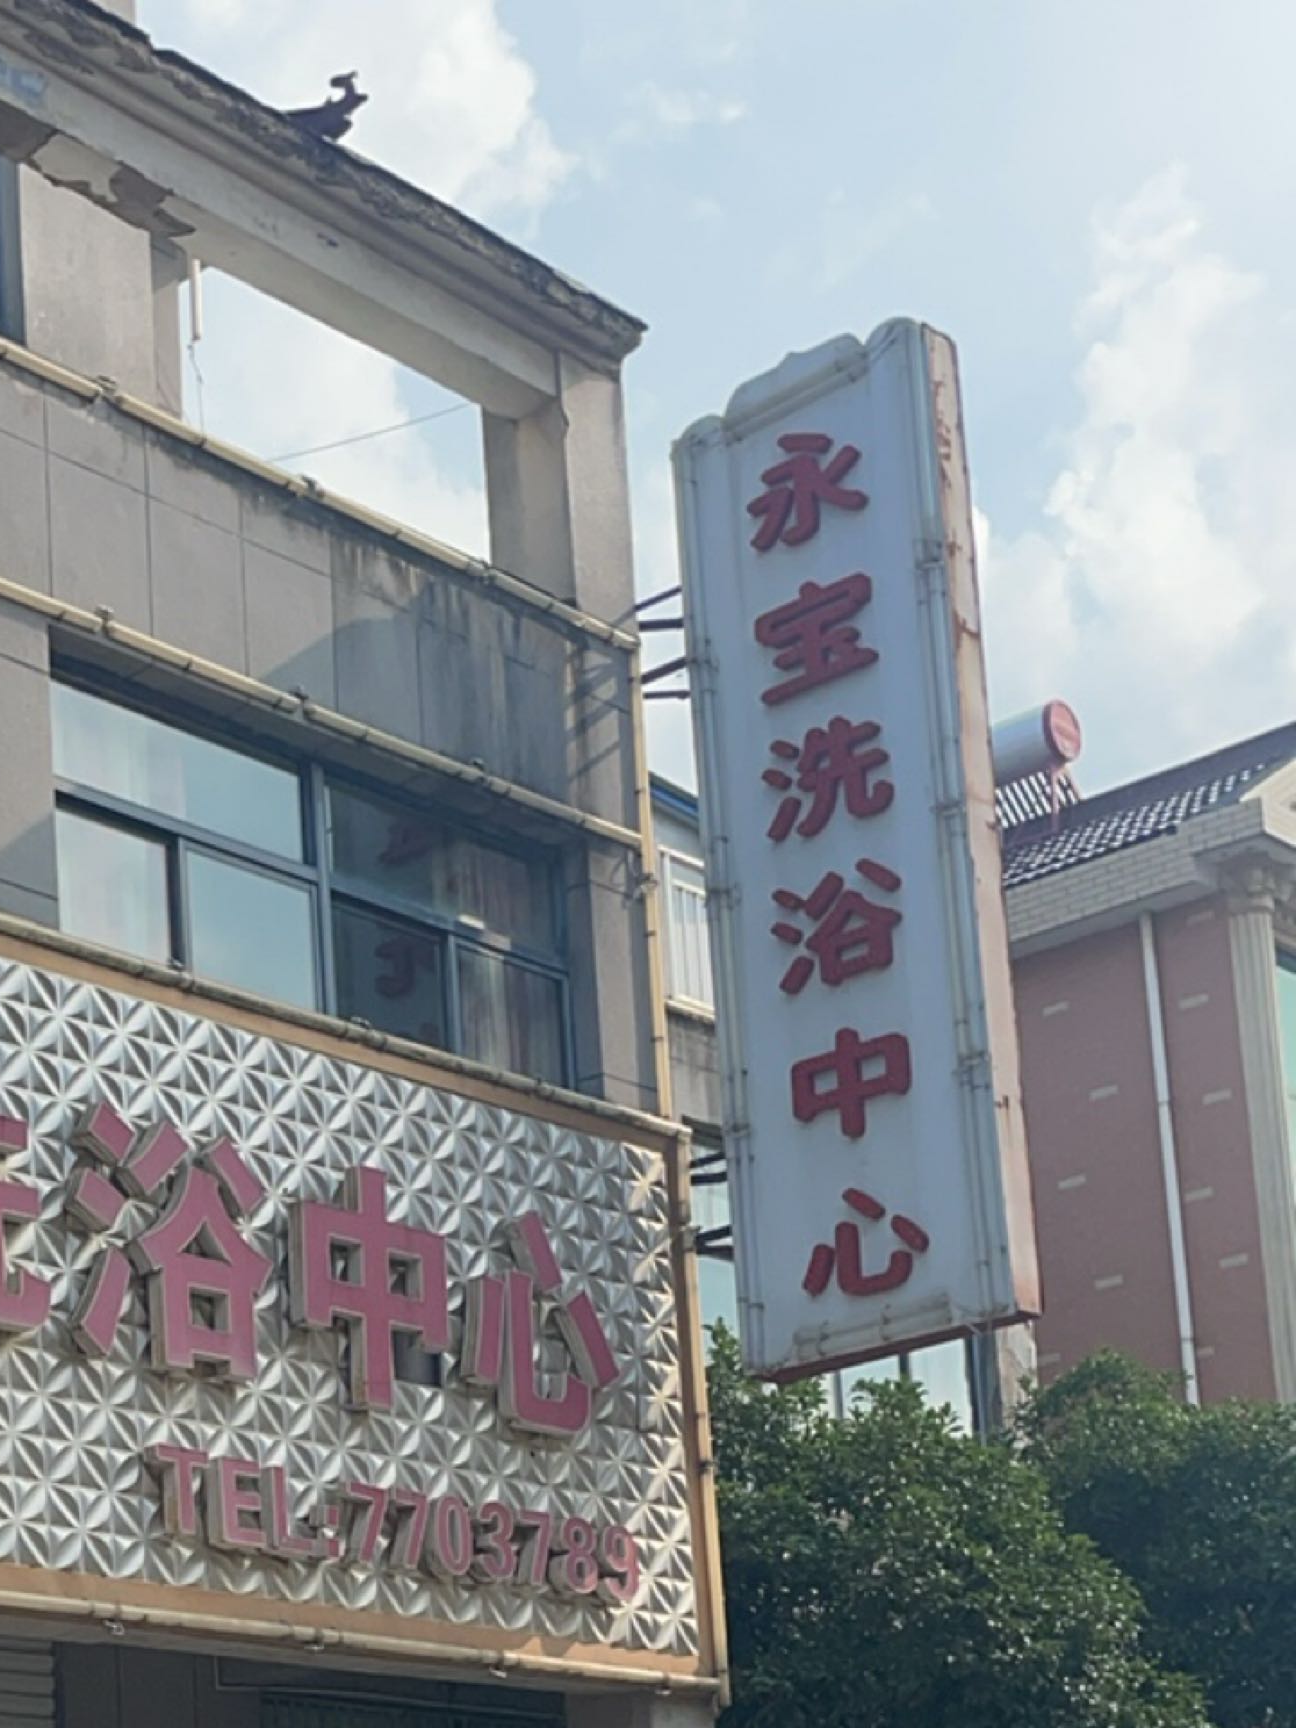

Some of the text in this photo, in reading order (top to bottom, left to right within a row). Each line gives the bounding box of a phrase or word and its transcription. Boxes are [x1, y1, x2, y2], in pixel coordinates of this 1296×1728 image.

[746, 432, 930, 1299] 永宝洗浴中心
